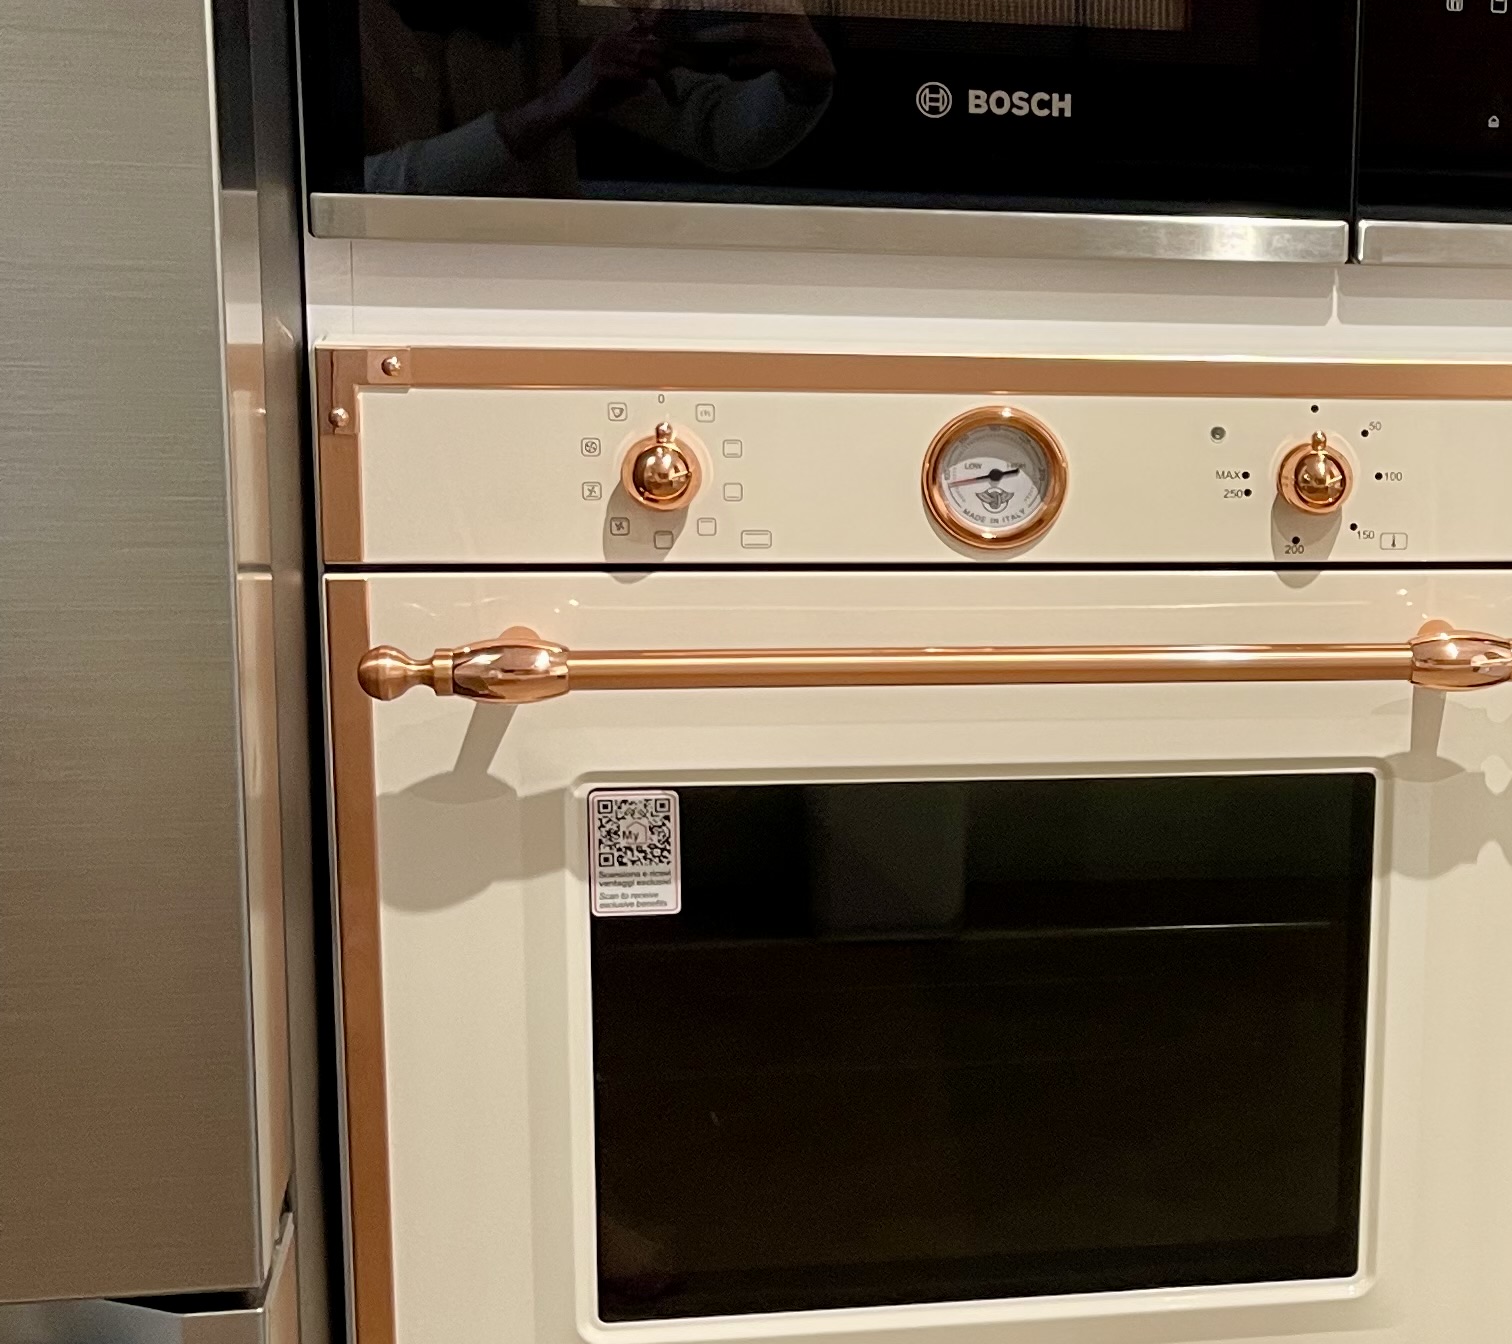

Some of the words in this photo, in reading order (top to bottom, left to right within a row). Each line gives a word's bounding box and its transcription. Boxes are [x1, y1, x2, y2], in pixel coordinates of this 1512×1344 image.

[967, 88, 1073, 118] BOSCH
[1368, 421, 1382, 431] 50
[964, 462, 983, 471] LOW
[1215, 469, 1242, 481] MAX
[1384, 471, 1403, 482] 100
[1223, 488, 1243, 499] 250
[962, 508, 987, 524] MADE
[989, 517, 1000, 525] IN
[1001, 509, 1026, 524] ITALY
[1356, 530, 1375, 540] 150
[1284, 544, 1305, 555] 200
